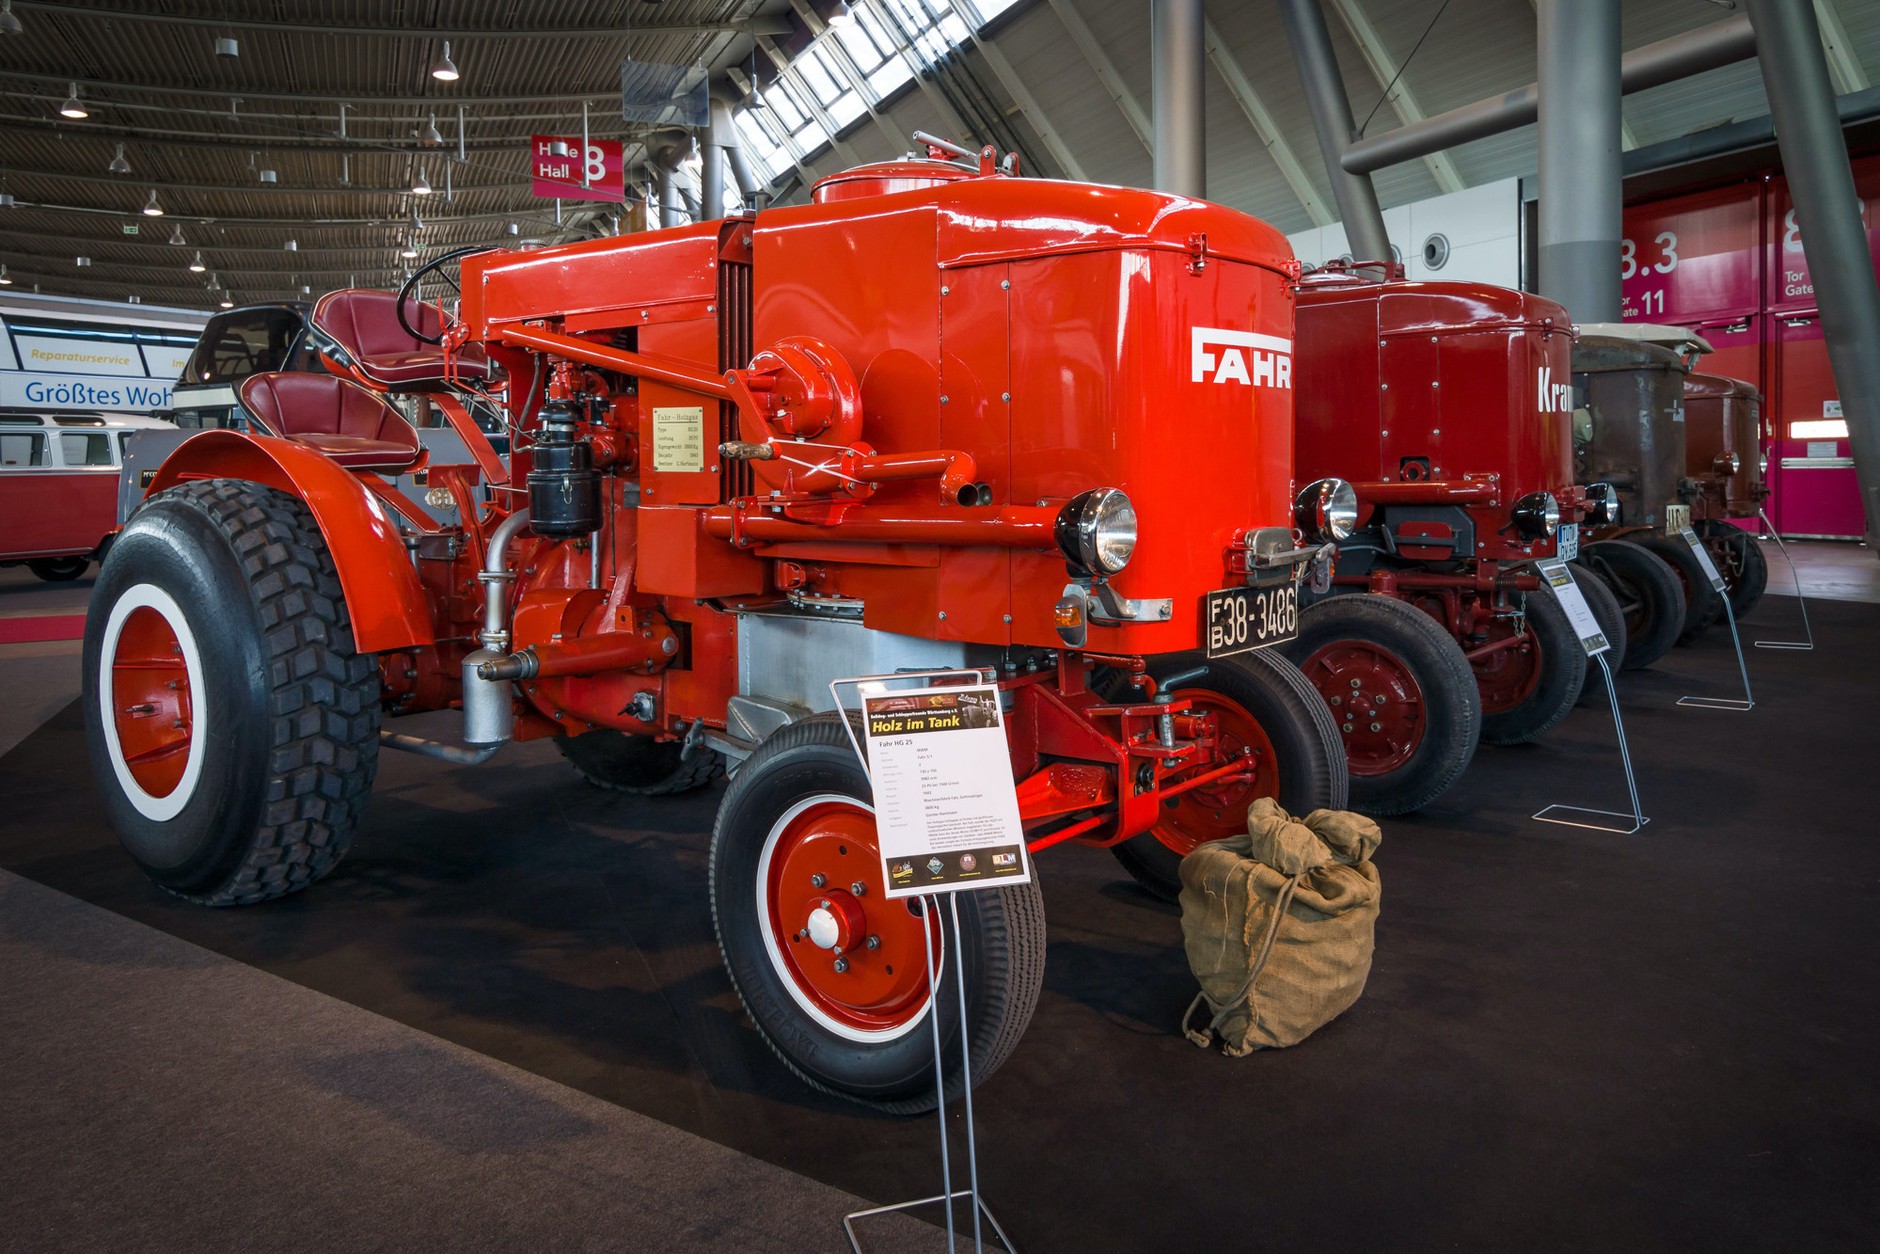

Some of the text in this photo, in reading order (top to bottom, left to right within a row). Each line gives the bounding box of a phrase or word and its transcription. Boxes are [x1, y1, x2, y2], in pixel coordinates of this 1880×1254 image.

[539, 142, 579, 158] Hle
[539, 163, 570, 178] Hall
[582, 145, 606, 181] 8
[1785, 270, 1804, 282] Tor
[1785, 284, 1814, 296] Gate
[1621, 297, 1631, 305] or
[1623, 289, 1664, 317] ate 11
[31, 348, 130, 366] Reparaturservice
[1191, 326, 1292, 389] FAHR
[25, 381, 173, 407] Größtes Woh
[1211, 599, 1222, 622] F
[1223, 587, 1296, 646] 38-3486
[1211, 626, 1223, 649] B
[872, 715, 960, 733] Holz im Tank
